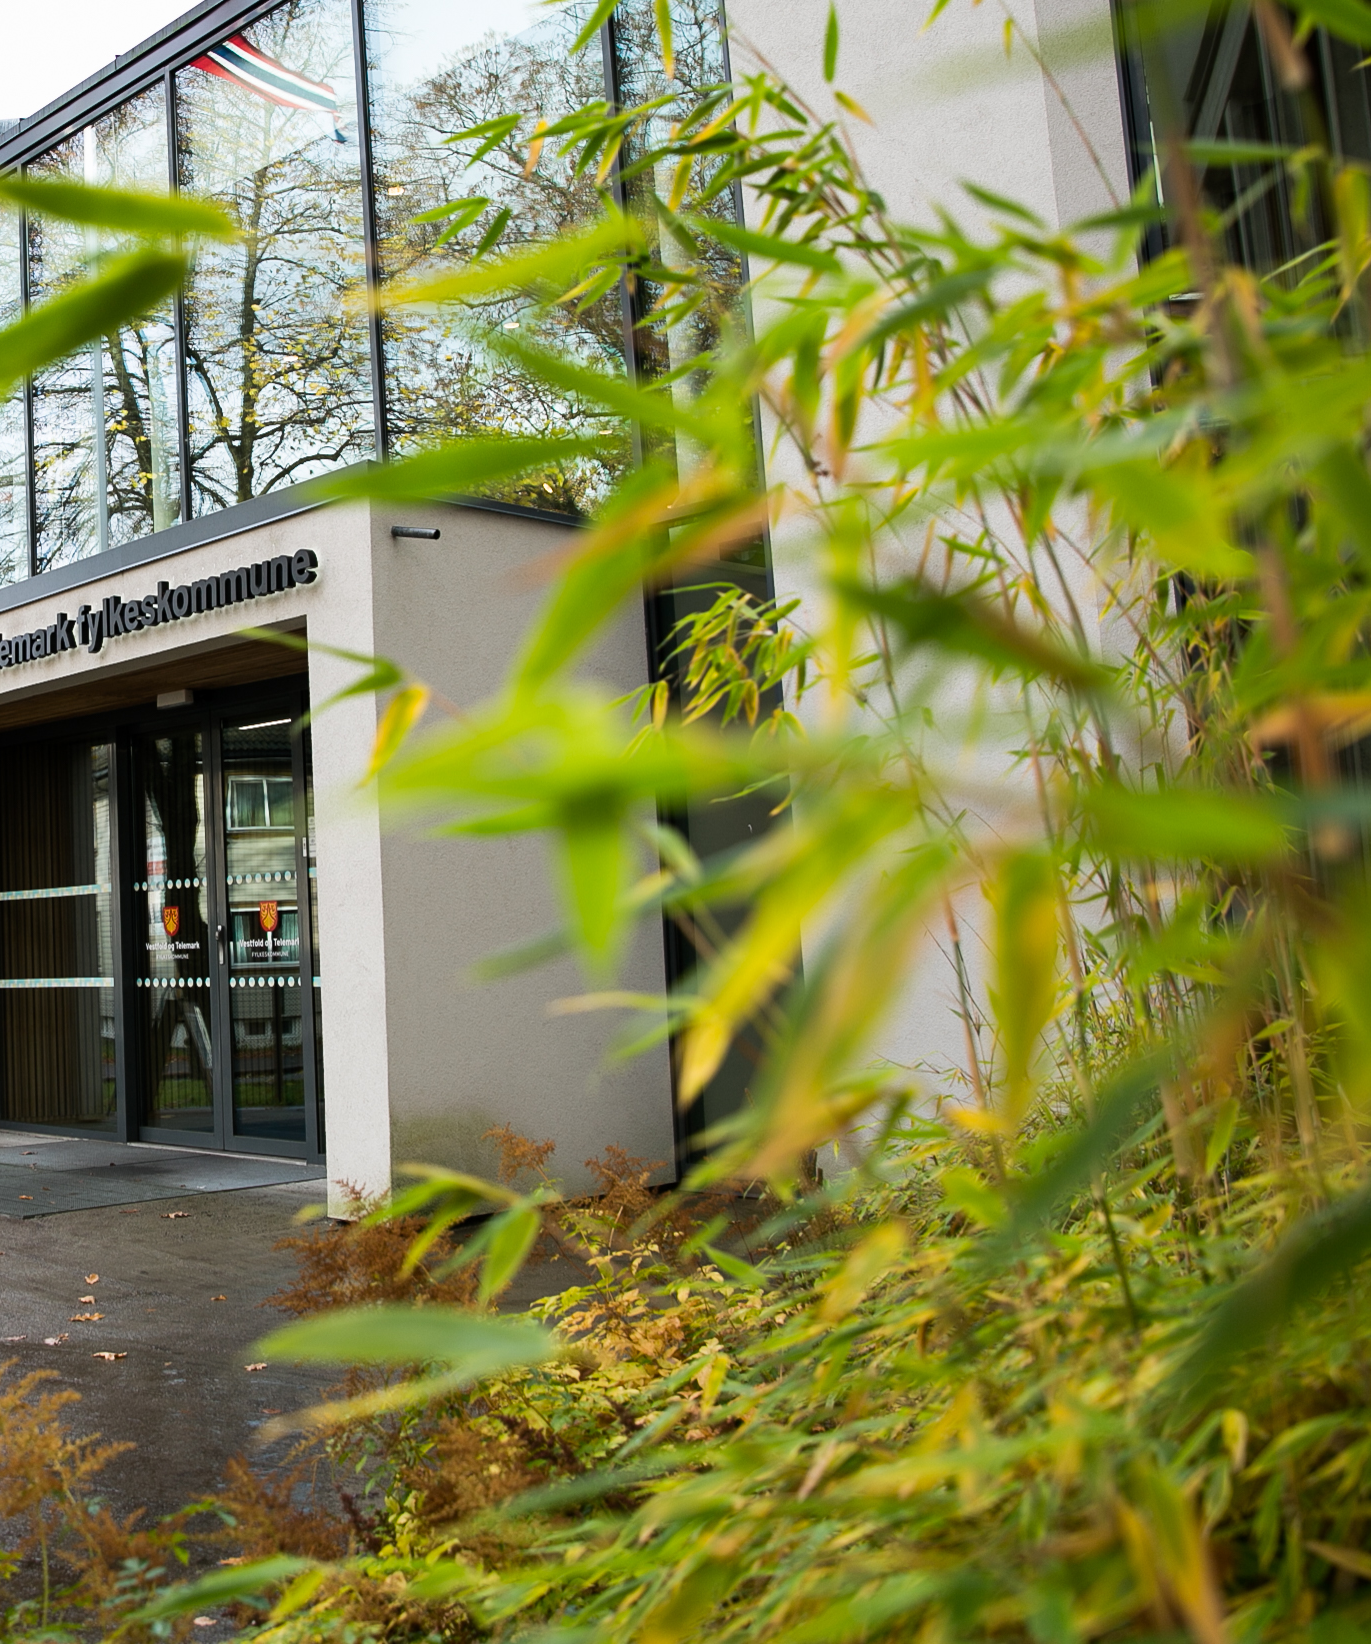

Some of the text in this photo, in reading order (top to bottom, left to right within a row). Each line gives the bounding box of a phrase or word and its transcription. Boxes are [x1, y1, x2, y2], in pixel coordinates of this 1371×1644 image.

[77, 548, 319, 653] fylkeskommune
[145, 941, 200, 952] Vestfold og Telemark
[240, 939, 264, 947] Vestfold
